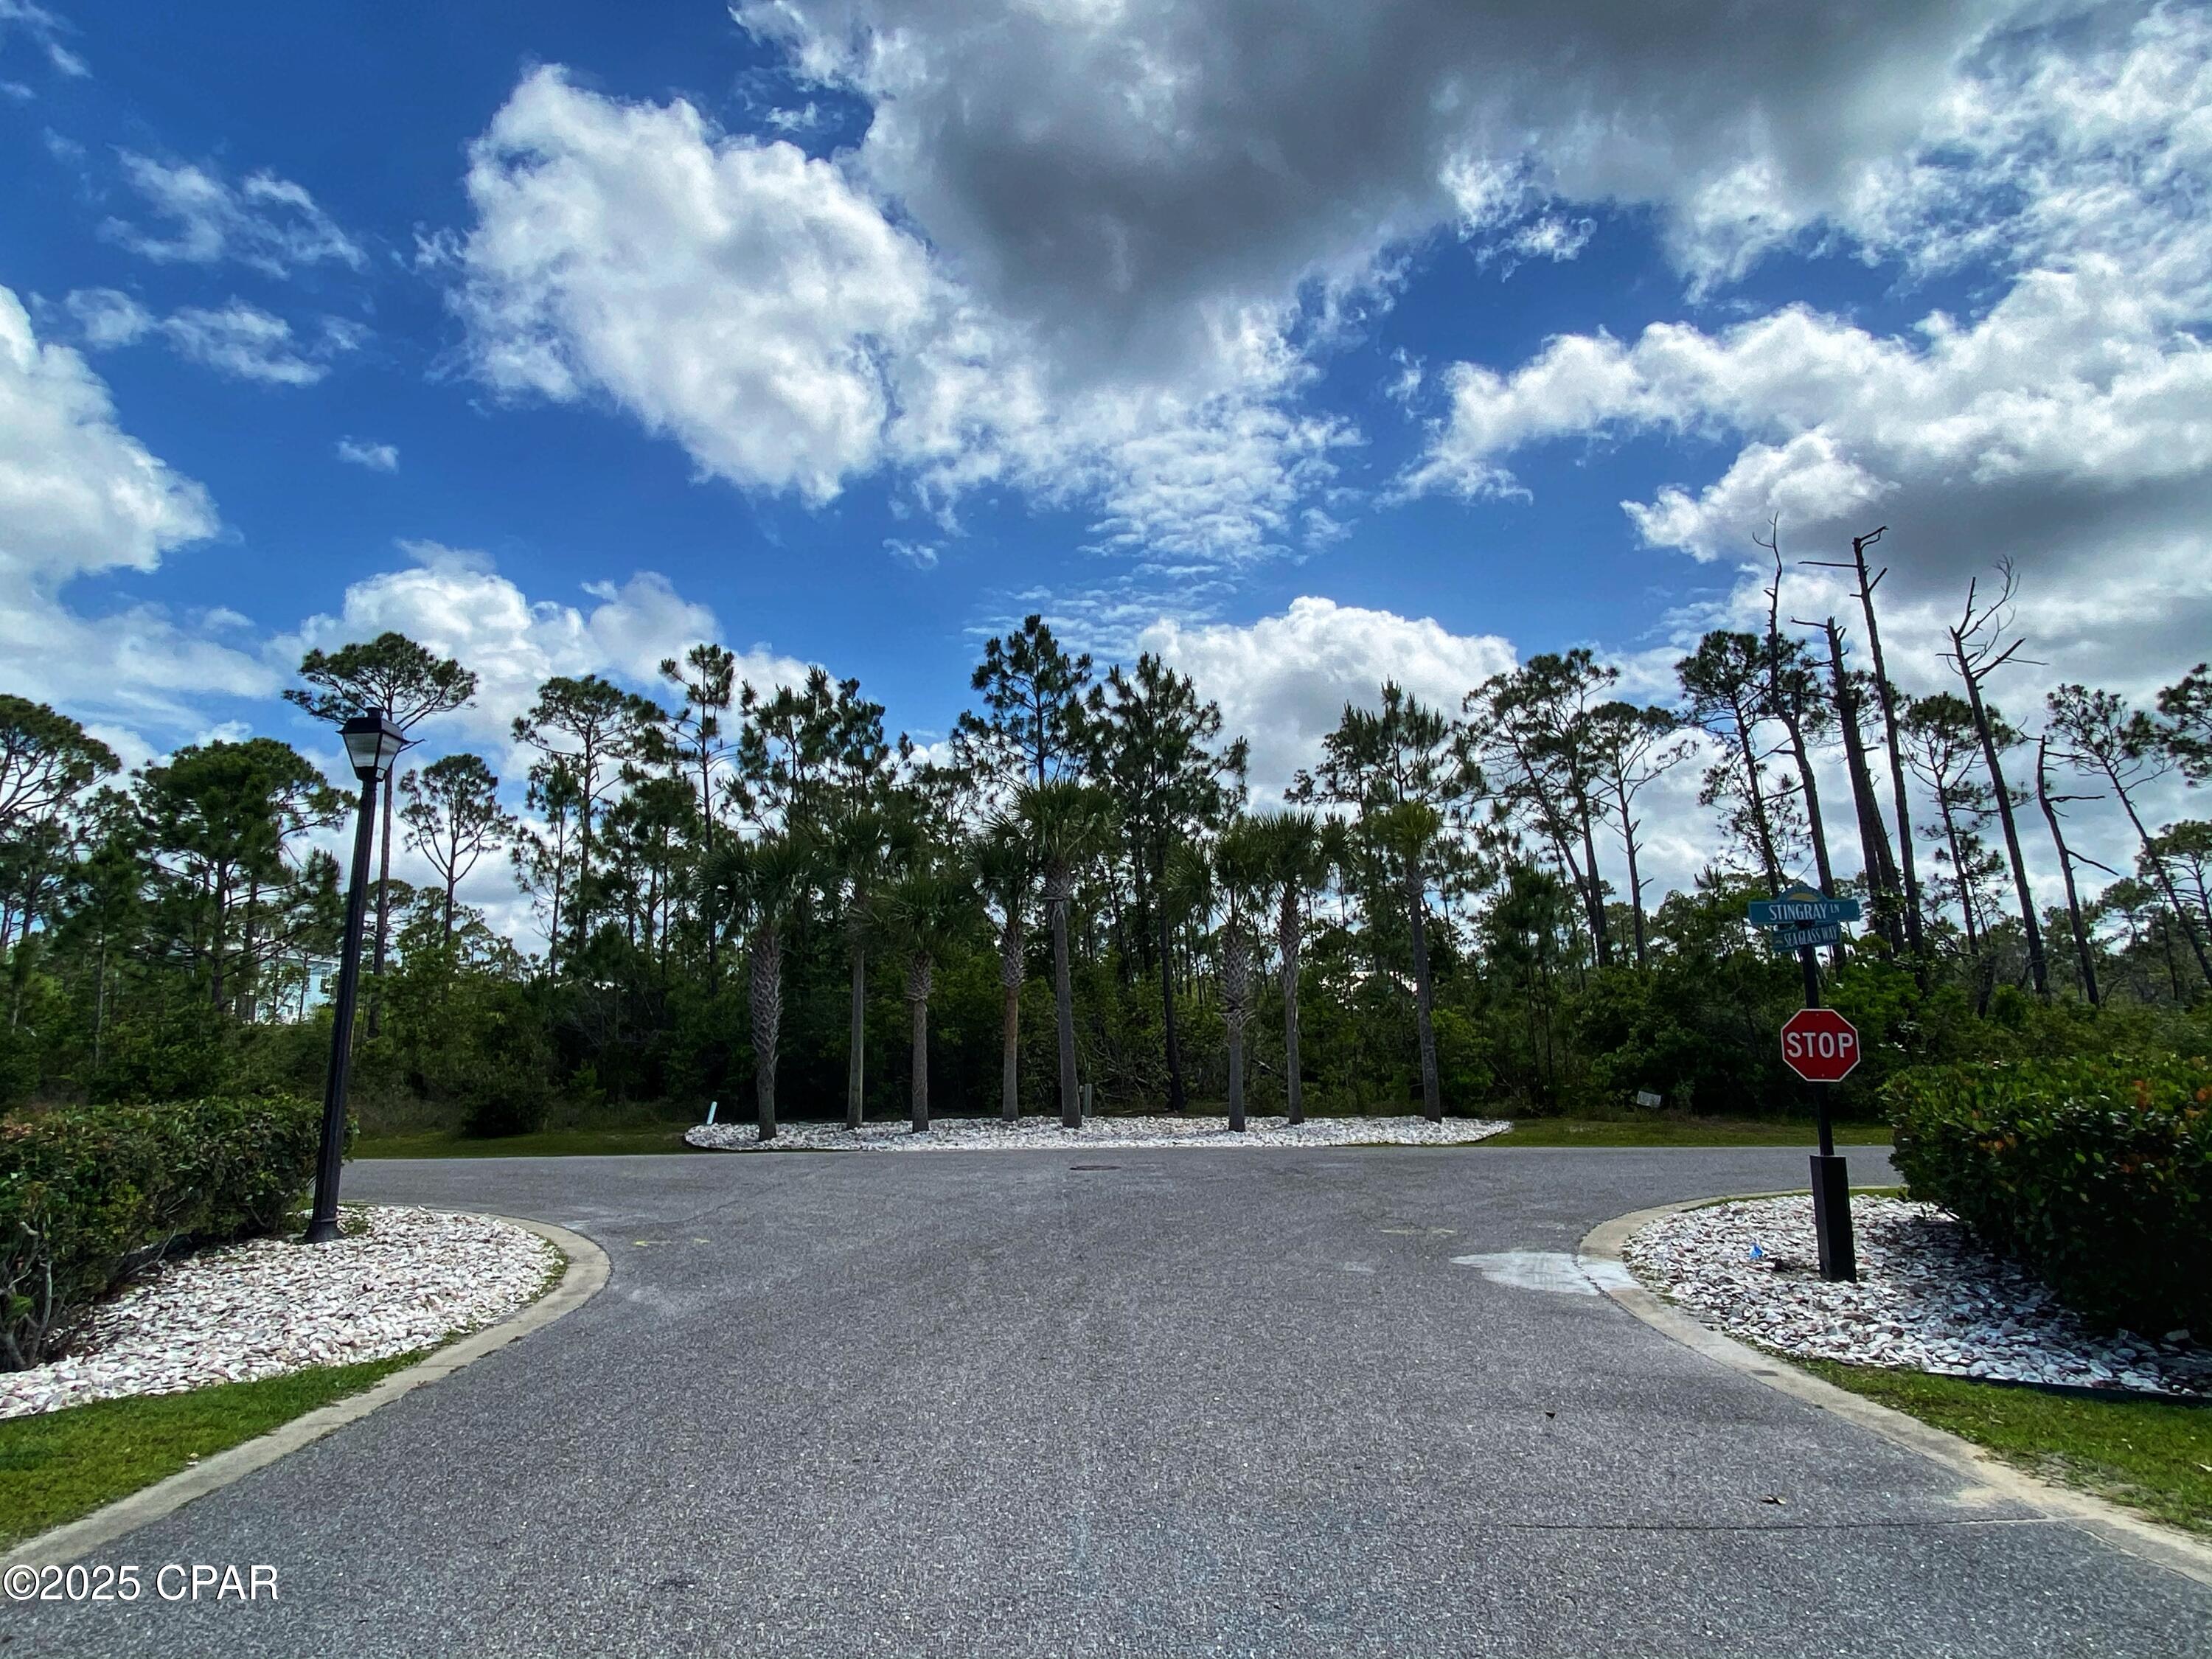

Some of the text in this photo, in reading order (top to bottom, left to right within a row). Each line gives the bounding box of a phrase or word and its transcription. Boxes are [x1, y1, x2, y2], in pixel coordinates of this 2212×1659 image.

[1769, 904, 1840, 921] STINGRAY LN
[1821, 925, 1837, 940] WAY
[1787, 1032, 1854, 1058] STOP
